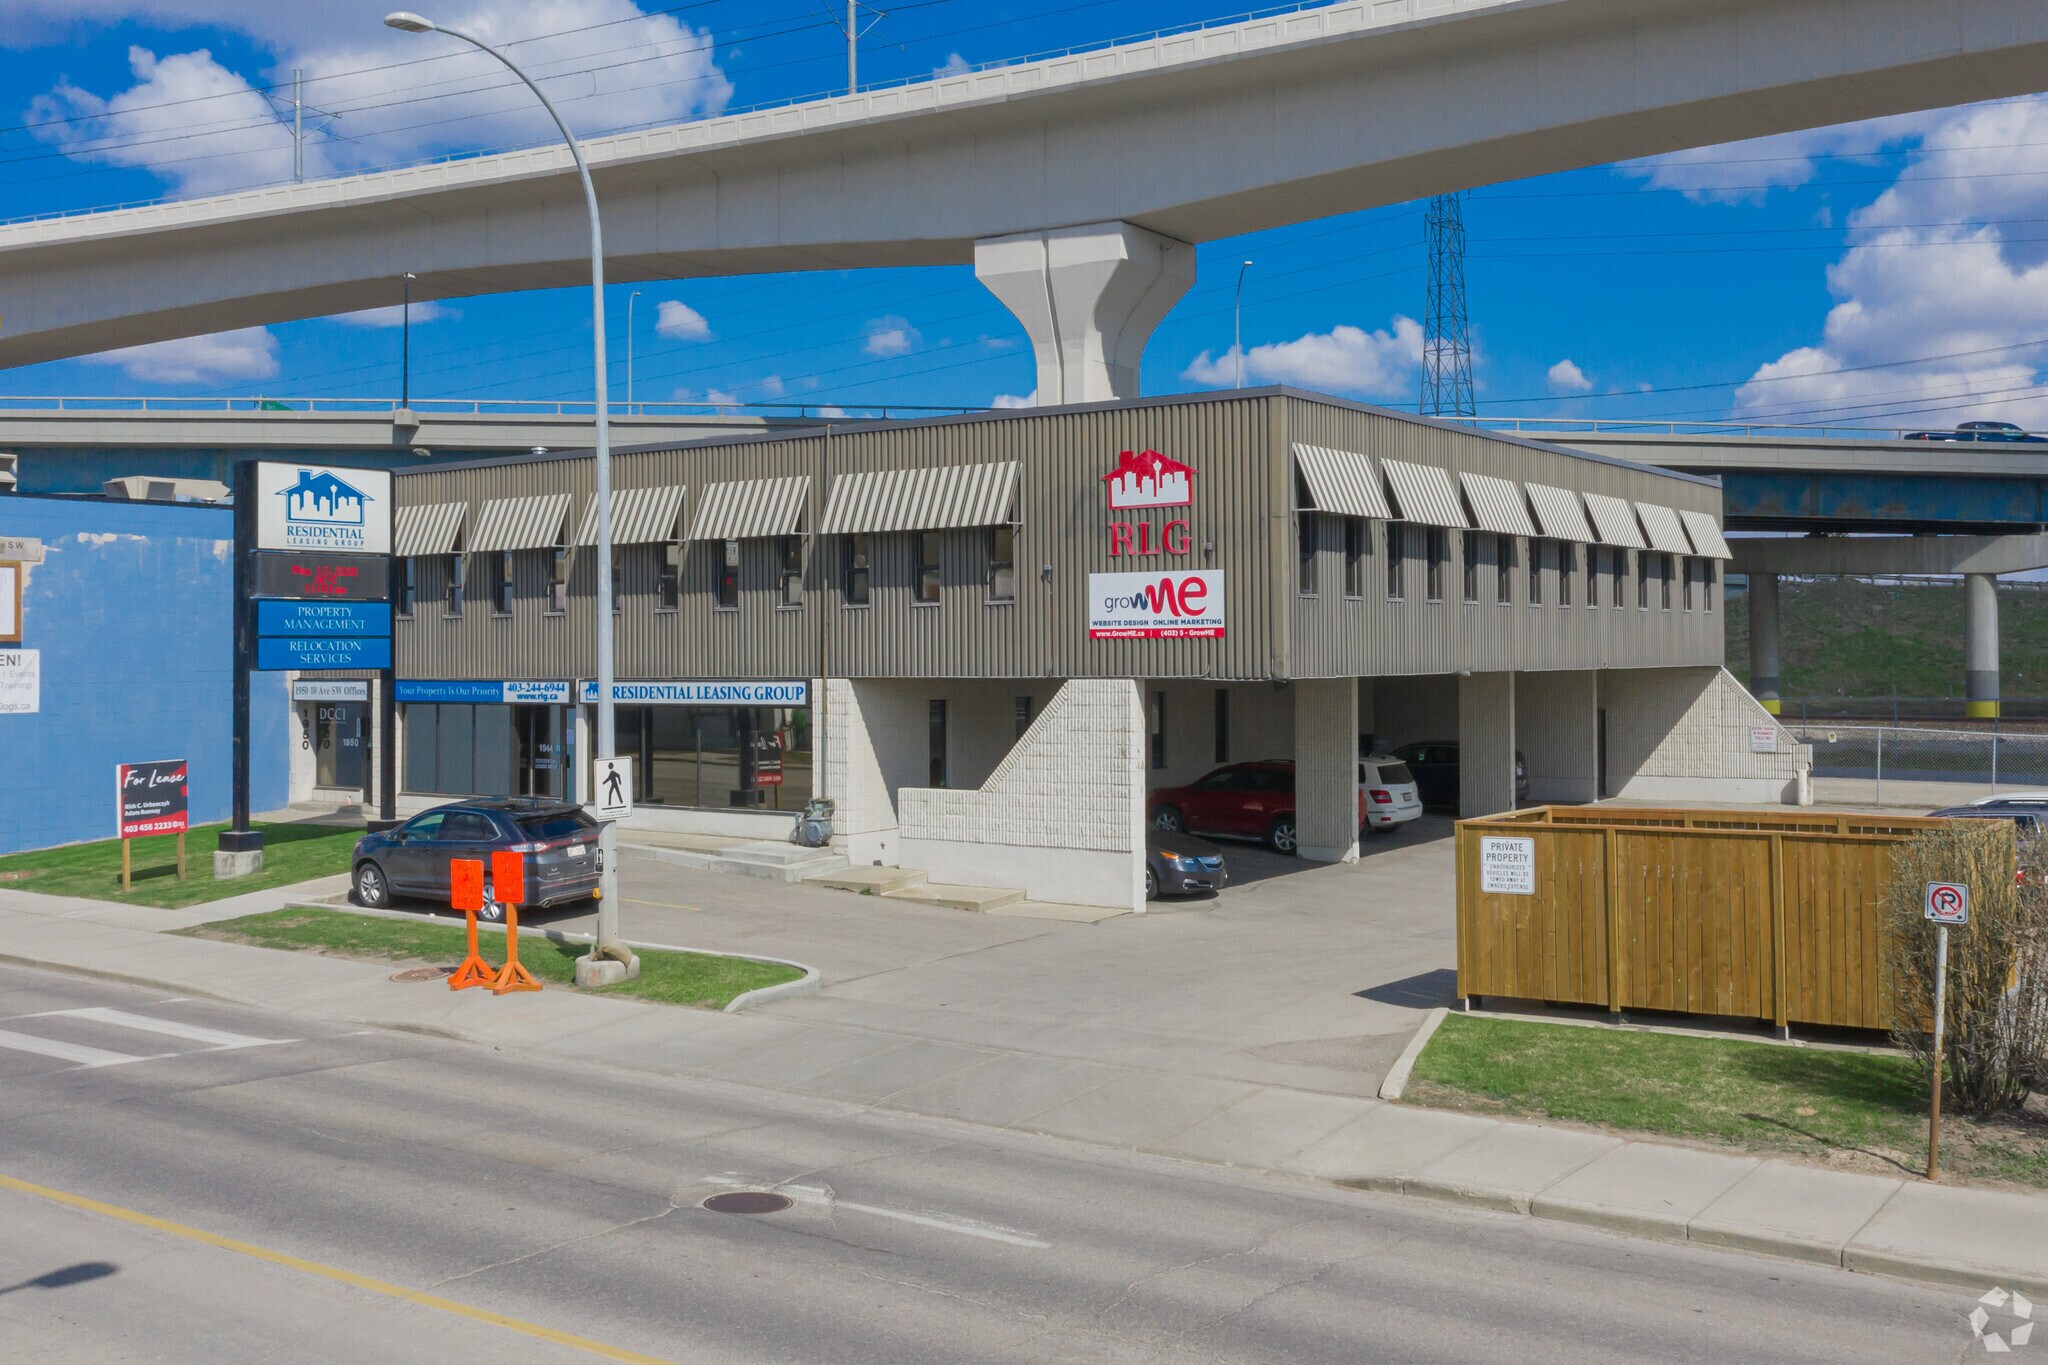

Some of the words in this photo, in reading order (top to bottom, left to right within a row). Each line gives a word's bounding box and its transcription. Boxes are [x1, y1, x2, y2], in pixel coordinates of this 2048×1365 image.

[287, 526, 364, 539] RESIDENTIAL
[1108, 519, 1192, 556] RLG
[287, 537, 328, 545] LEASING
[334, 538, 364, 547] GROUP
[298, 606, 353, 617] PROPERTY
[284, 619, 366, 629] MANAGEMENT
[1161, 629, 1178, 637] (403)
[290, 641, 361, 651] RELOCATION
[300, 653, 352, 664] SERVICES
[9, 670, 36, 678] Events
[0, 681, 32, 690] Training
[507, 682, 565, 692] 403-244-6944
[295, 686, 309, 695] 1950
[320, 687, 331, 695] Ave
[332, 687, 342, 695] SW
[344, 686, 367, 696] Offices
[399, 686, 415, 695] Your
[416, 686, 447, 697] Property
[448, 686, 455, 695] Is
[456, 687, 470, 695] Our
[471, 686, 499, 698] Priority
[612, 685, 693, 700] RESIDENTIAL
[697, 685, 751, 700] LEASING
[754, 685, 804, 701] GROUP
[319, 707, 346, 720] DCCI
[343, 738, 359, 747] 1950
[539, 743, 553, 752] 1944
[124, 770, 146, 788] For
[149, 769, 185, 788] Lease
[154, 821, 172, 830] 2233
[1491, 842, 1523, 851] PRIVATE
[1486, 853, 1528, 862] PROPERTY
